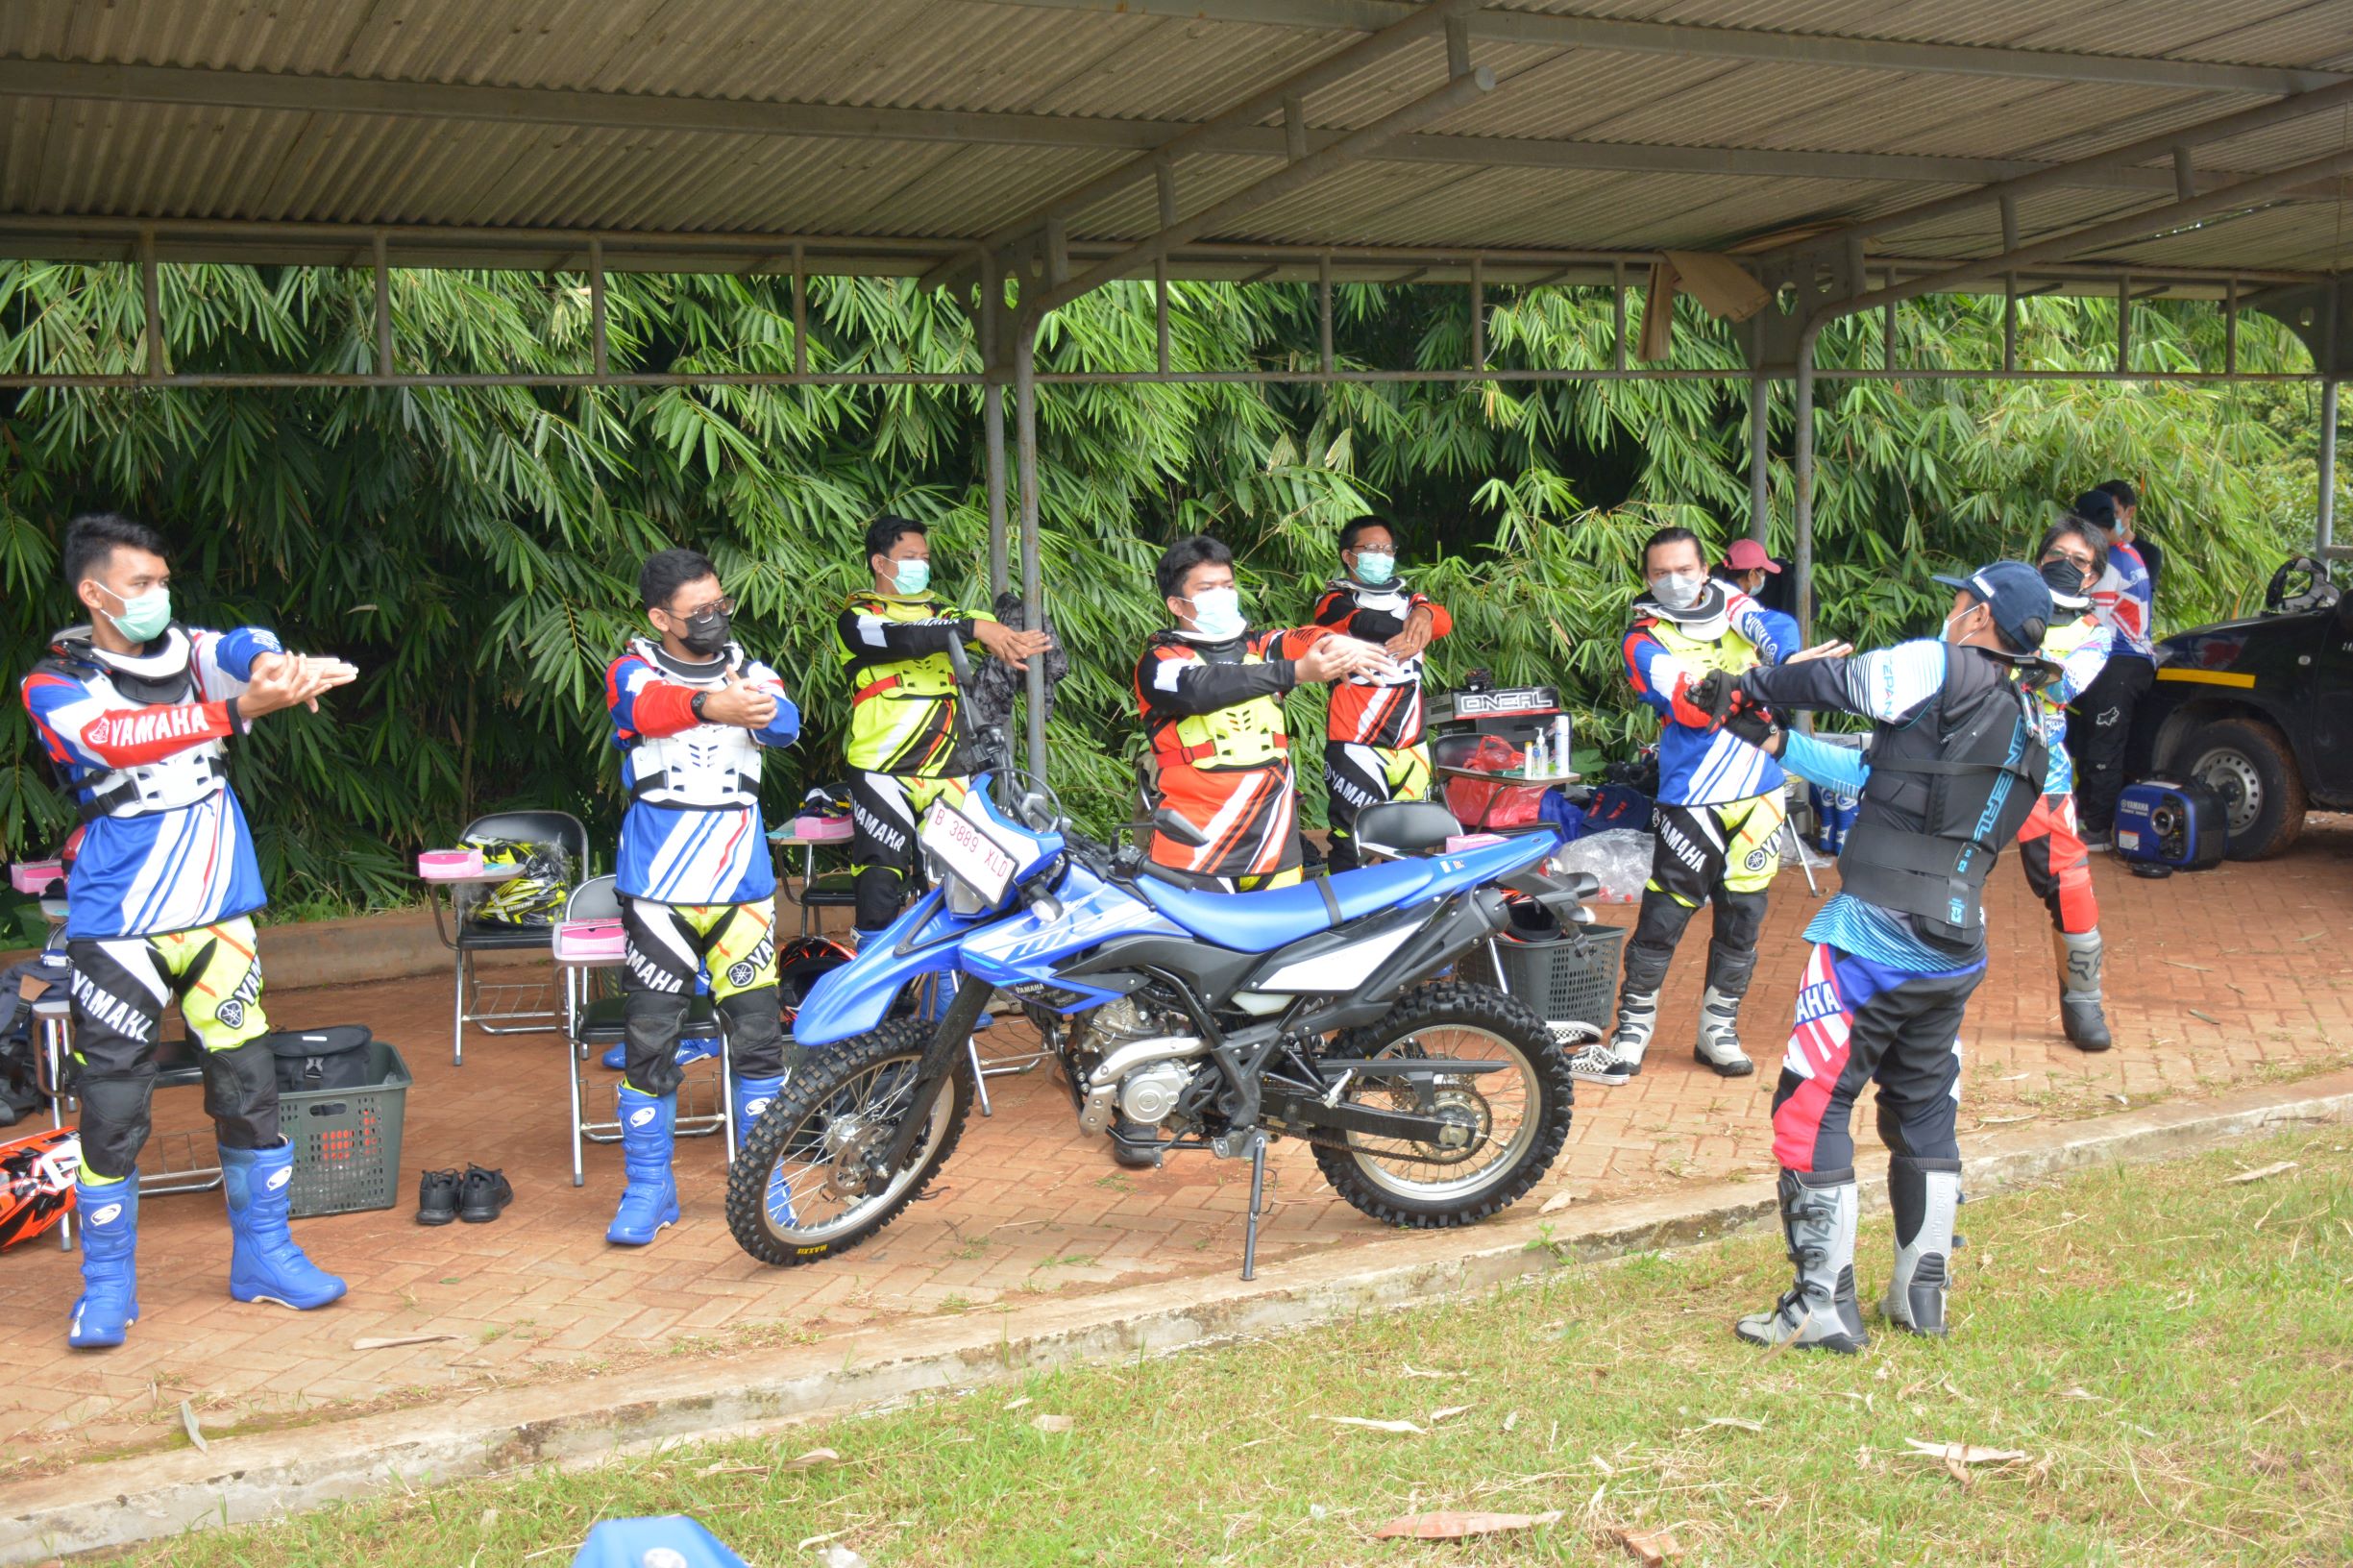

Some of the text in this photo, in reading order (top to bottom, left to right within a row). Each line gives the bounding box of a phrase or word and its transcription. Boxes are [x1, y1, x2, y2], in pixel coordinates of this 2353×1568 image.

[110, 705, 210, 747] YAMAHA
[935, 809, 1008, 877] B 3889 XLD
[1659, 815, 1707, 872] YAMAHA
[1015, 983, 1044, 993] YAMAHA
[797, 1244, 828, 1255] MAXXIS
